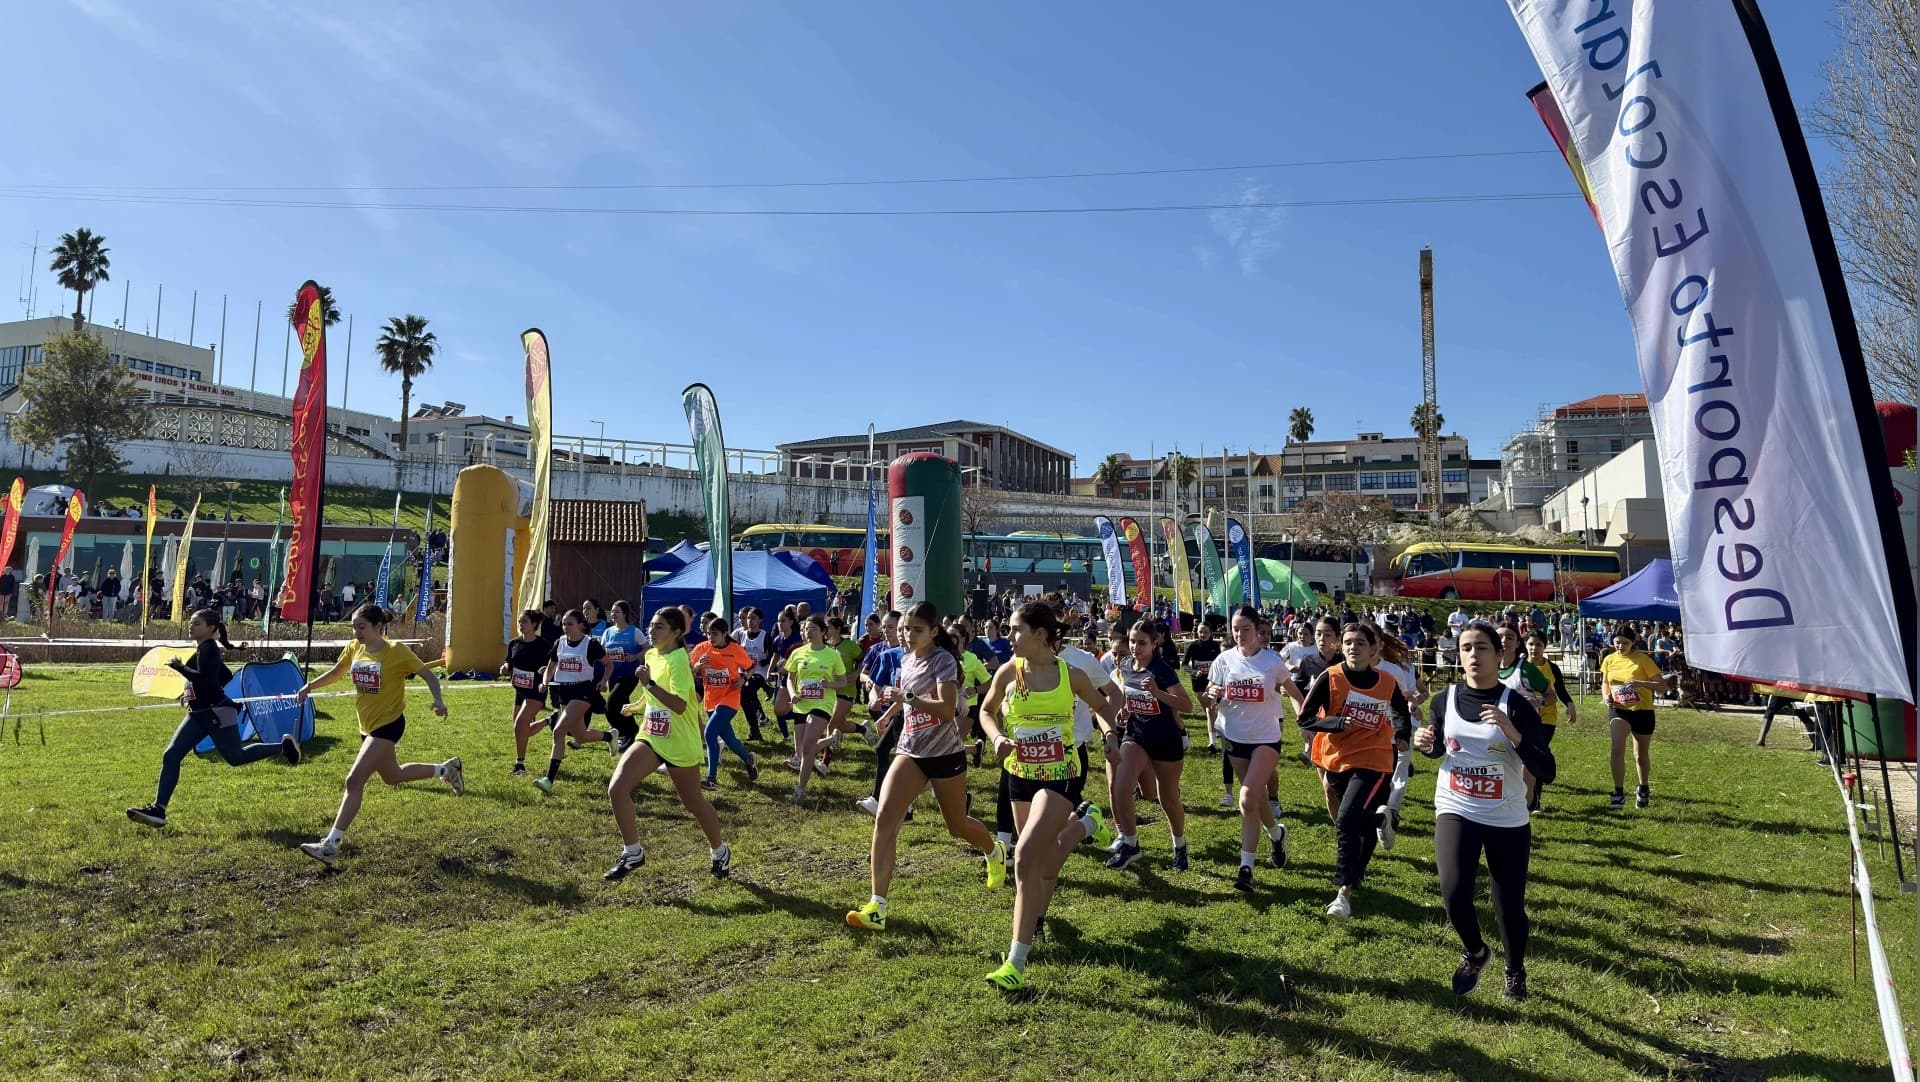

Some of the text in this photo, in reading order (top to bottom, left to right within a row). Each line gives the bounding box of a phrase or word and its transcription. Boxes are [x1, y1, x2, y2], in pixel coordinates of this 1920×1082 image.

[1230, 687, 1260, 698] 3919
[1130, 699, 1154, 711] 3982
[1348, 707, 1380, 724] 3906
[1021, 744, 1056, 758] 3921
[1454, 773, 1496, 793] 3912
